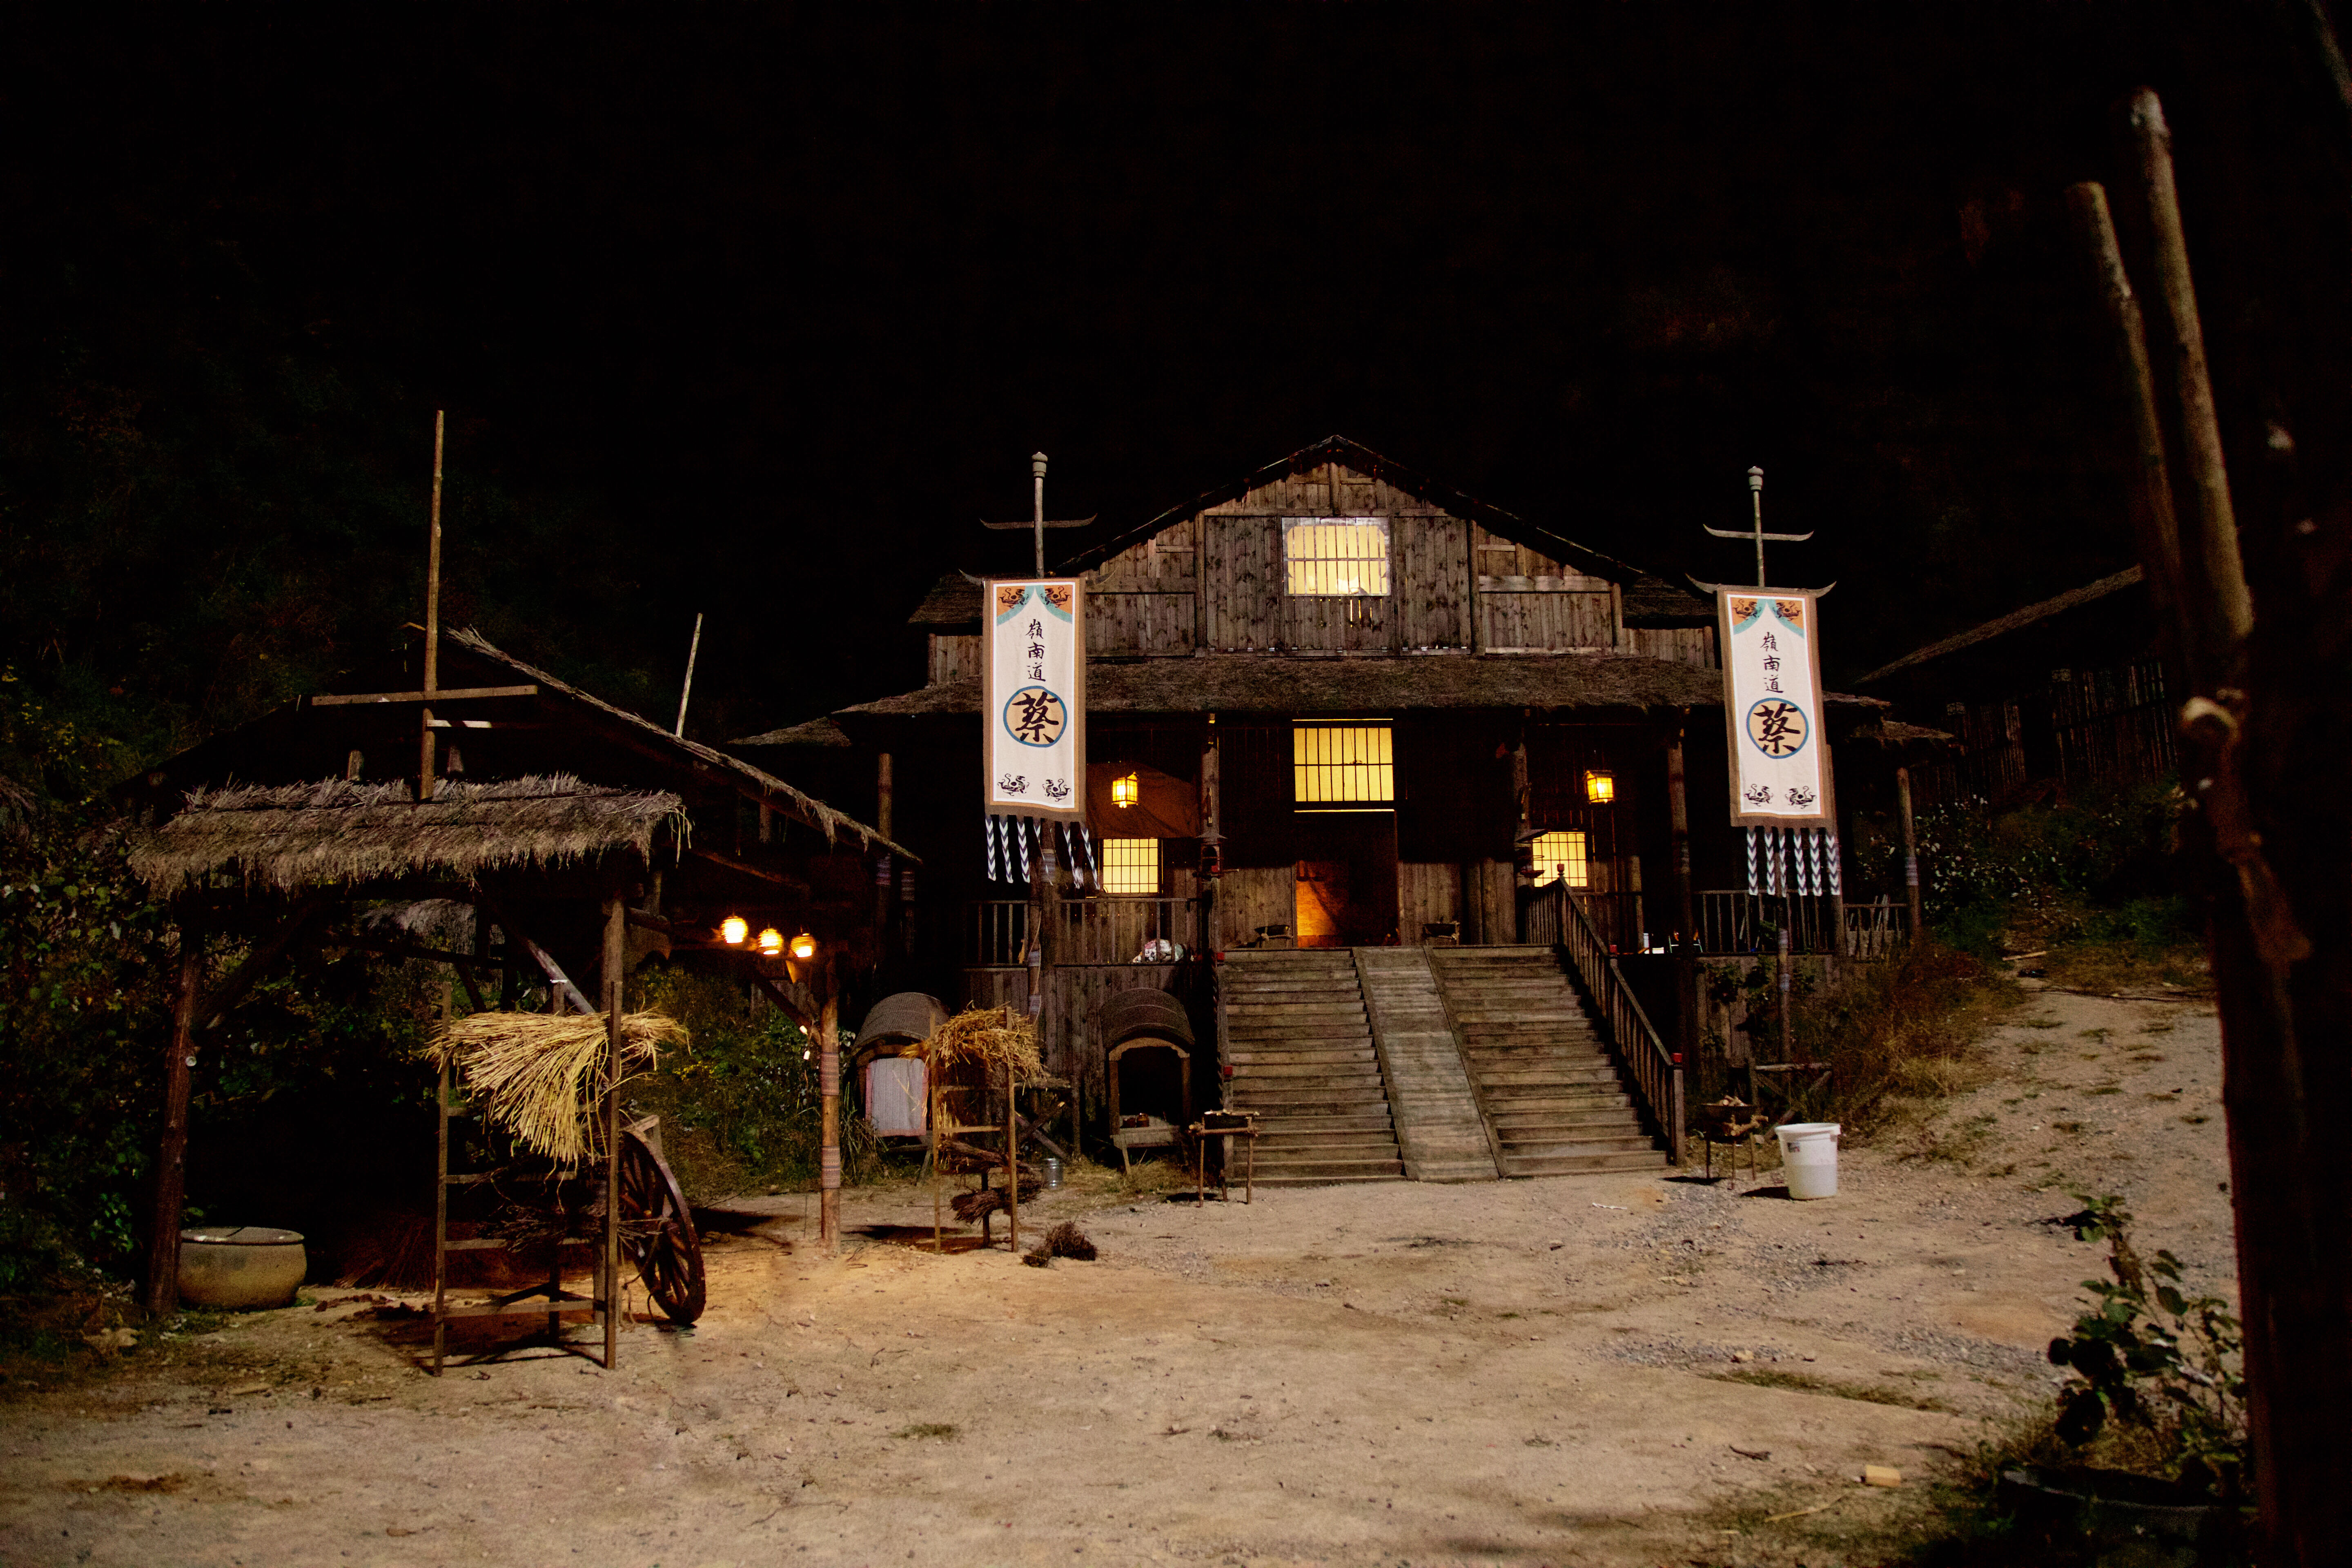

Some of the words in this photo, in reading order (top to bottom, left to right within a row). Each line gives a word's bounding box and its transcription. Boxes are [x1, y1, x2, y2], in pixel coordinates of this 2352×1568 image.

[1025, 619, 1046, 682] 嶺南道
[1760, 632, 1784, 693] 嶺南道
[1012, 691, 1059, 743] 蔡
[1754, 703, 1800, 754] 蔡
